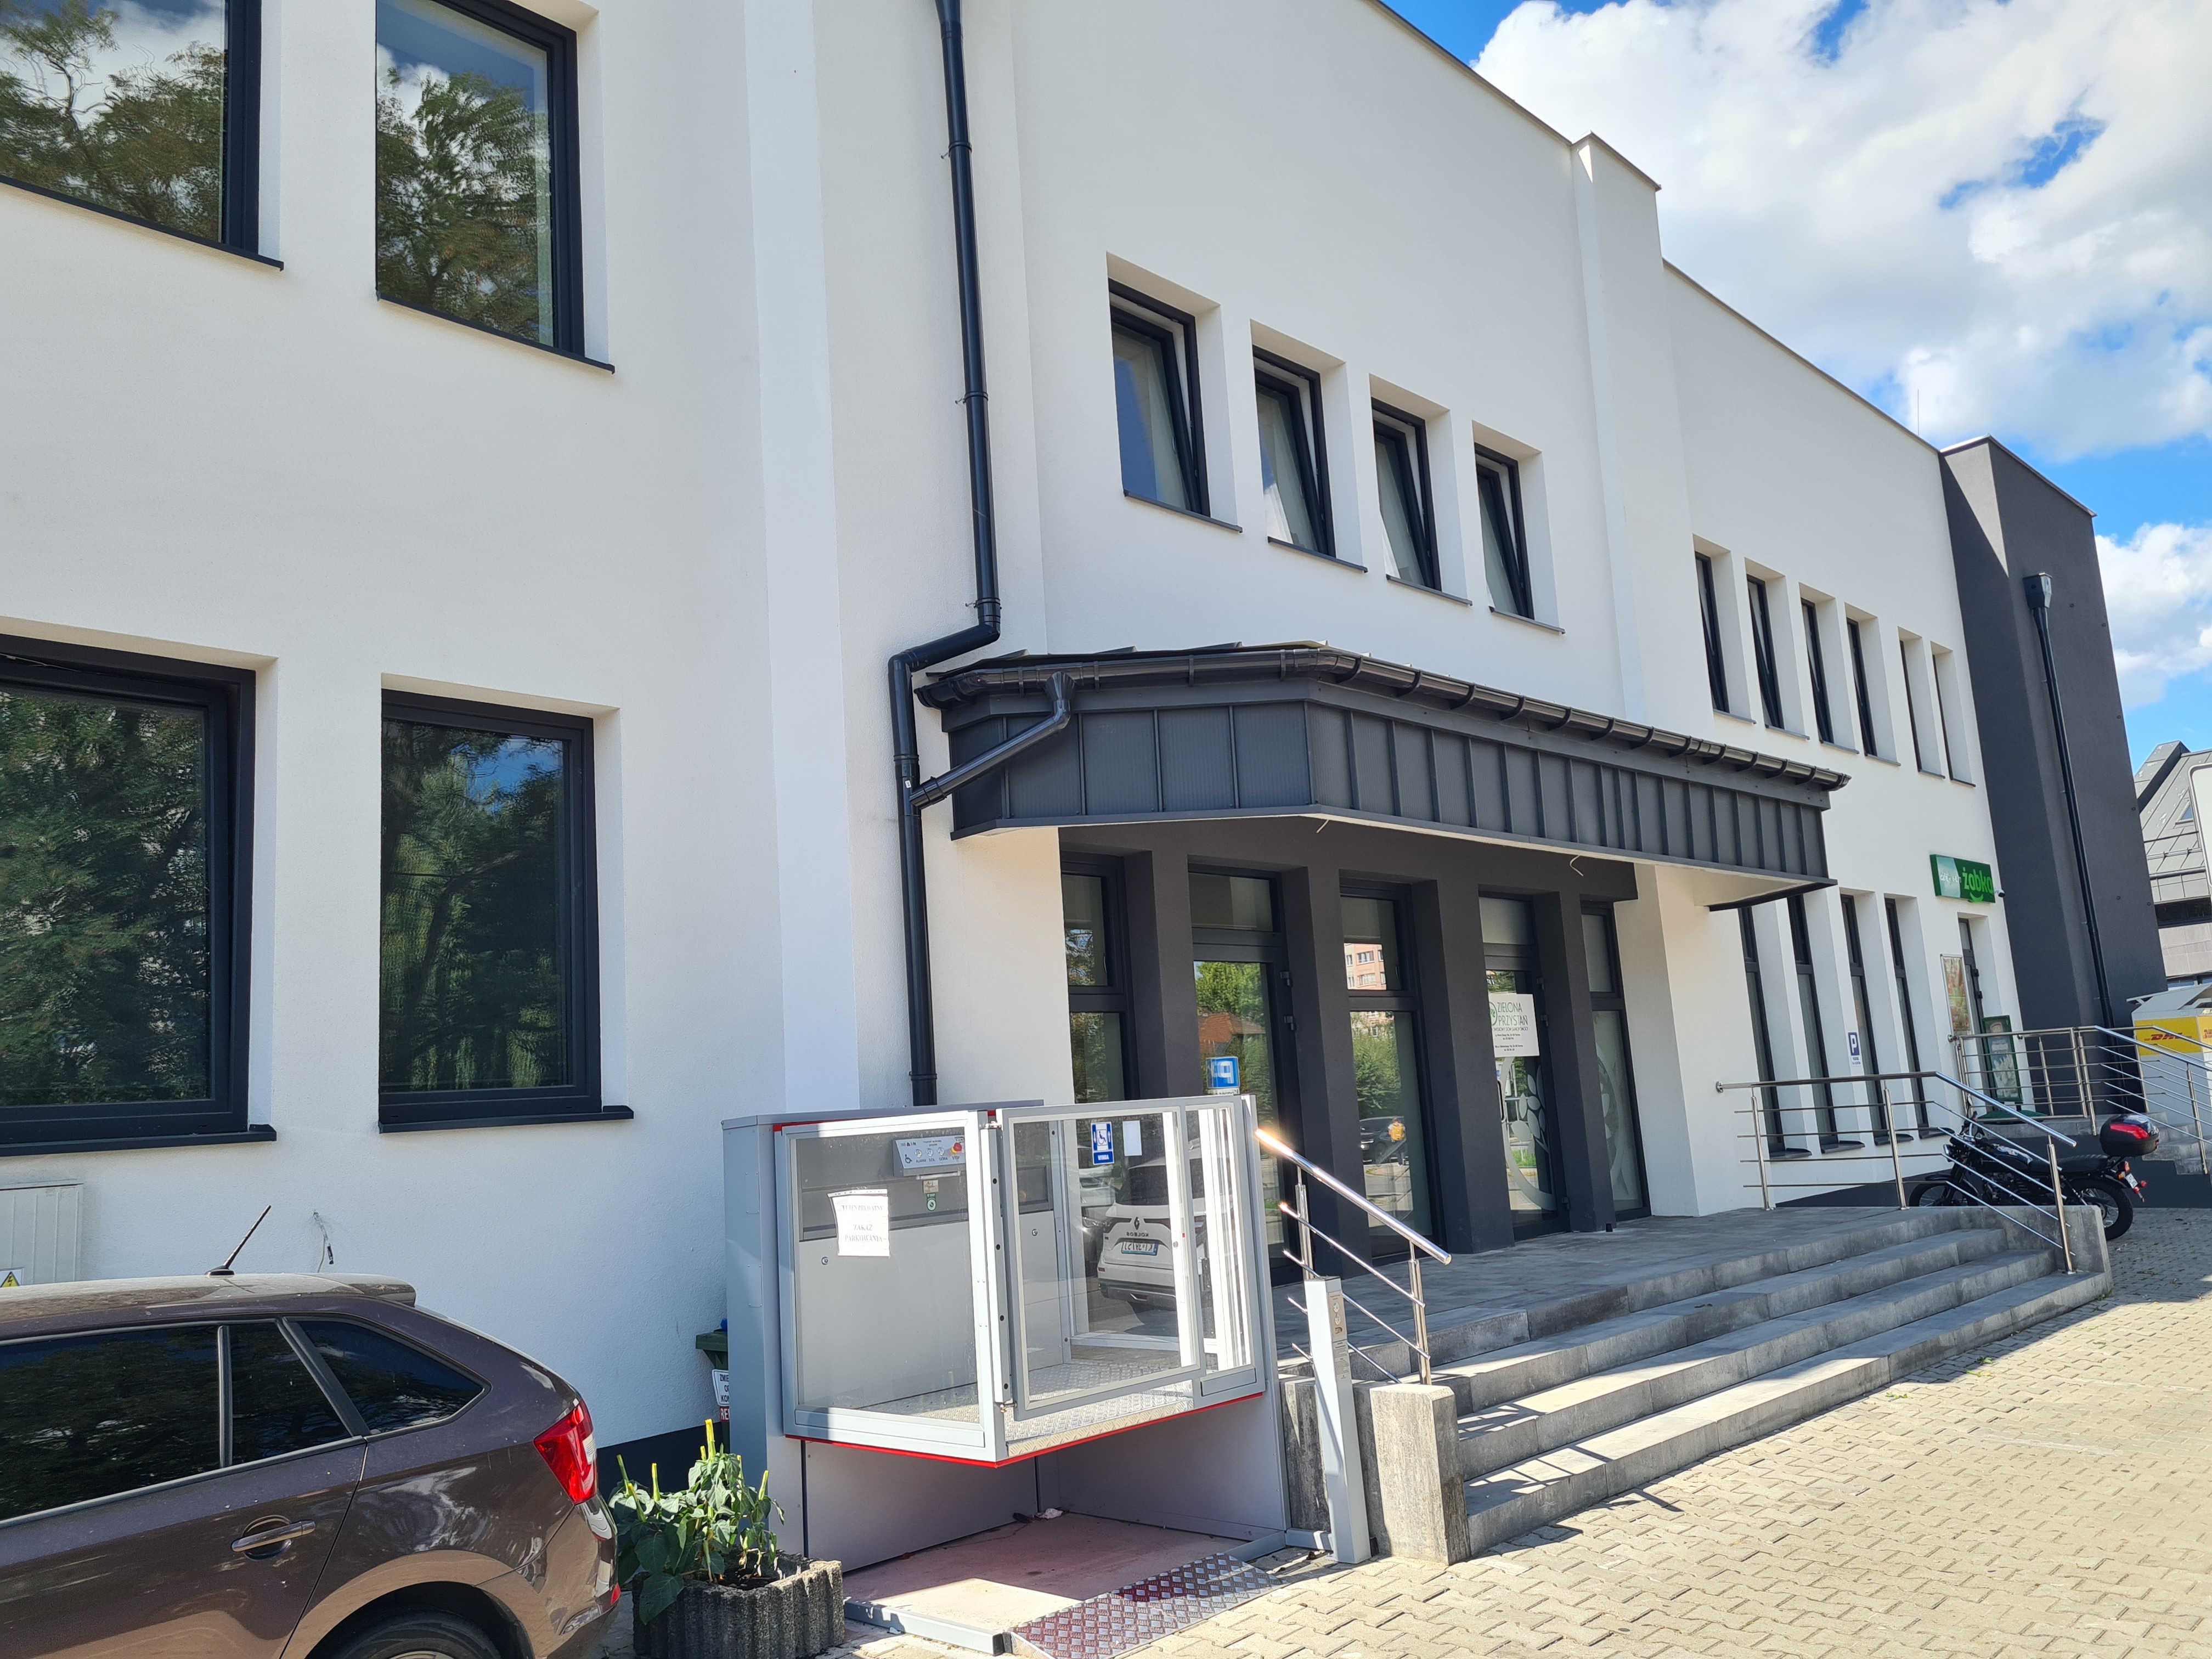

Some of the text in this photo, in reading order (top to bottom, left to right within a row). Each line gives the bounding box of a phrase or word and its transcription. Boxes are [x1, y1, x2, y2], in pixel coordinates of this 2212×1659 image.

[1962, 867, 1993, 894] żabka
[1497, 1002, 1522, 1012] ZIELONA
[1850, 1035, 1857, 1053] P
